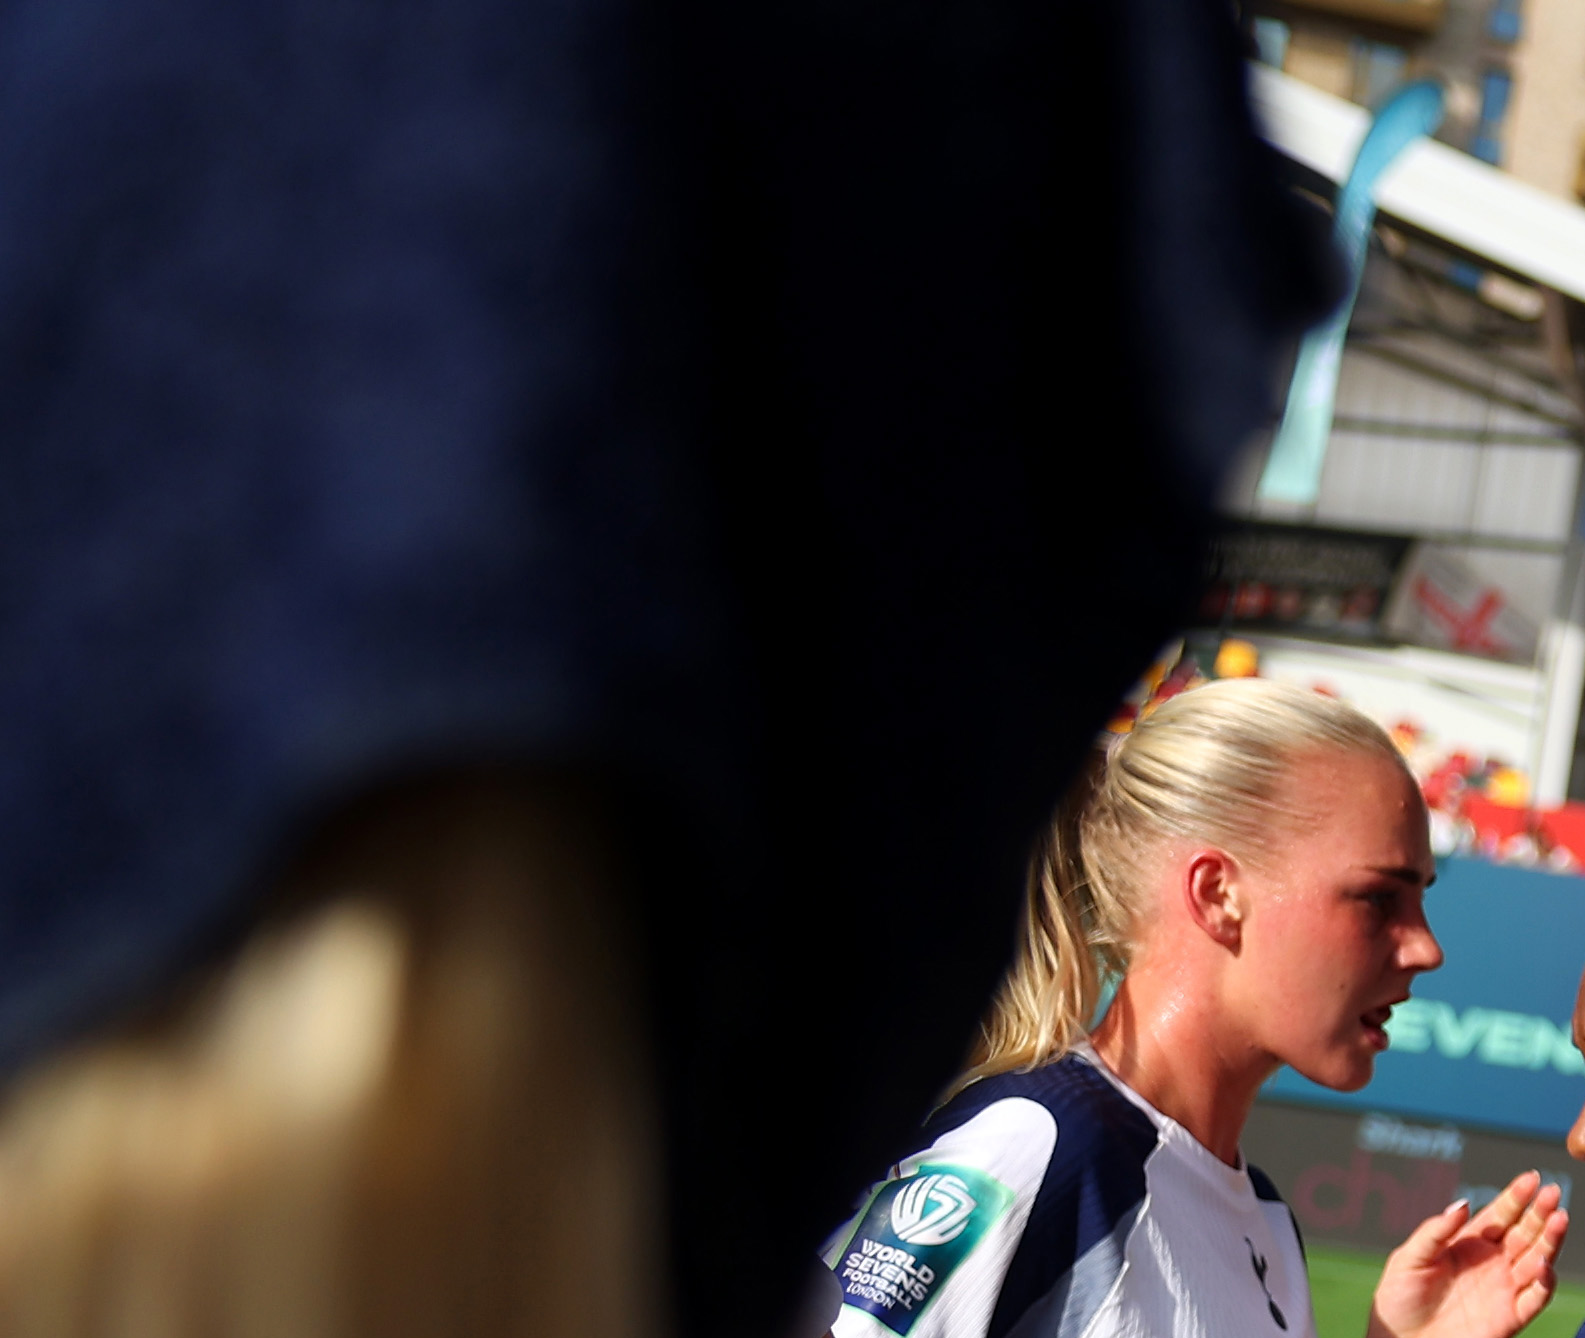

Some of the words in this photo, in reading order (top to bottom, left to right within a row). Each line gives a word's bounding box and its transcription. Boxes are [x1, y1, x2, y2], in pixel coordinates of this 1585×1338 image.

[845, 1252, 929, 1301] SEVENS
[861, 1238, 936, 1286] WORLD
[842, 1268, 913, 1311] FOOTBALL
[846, 1282, 897, 1310] LONDON
